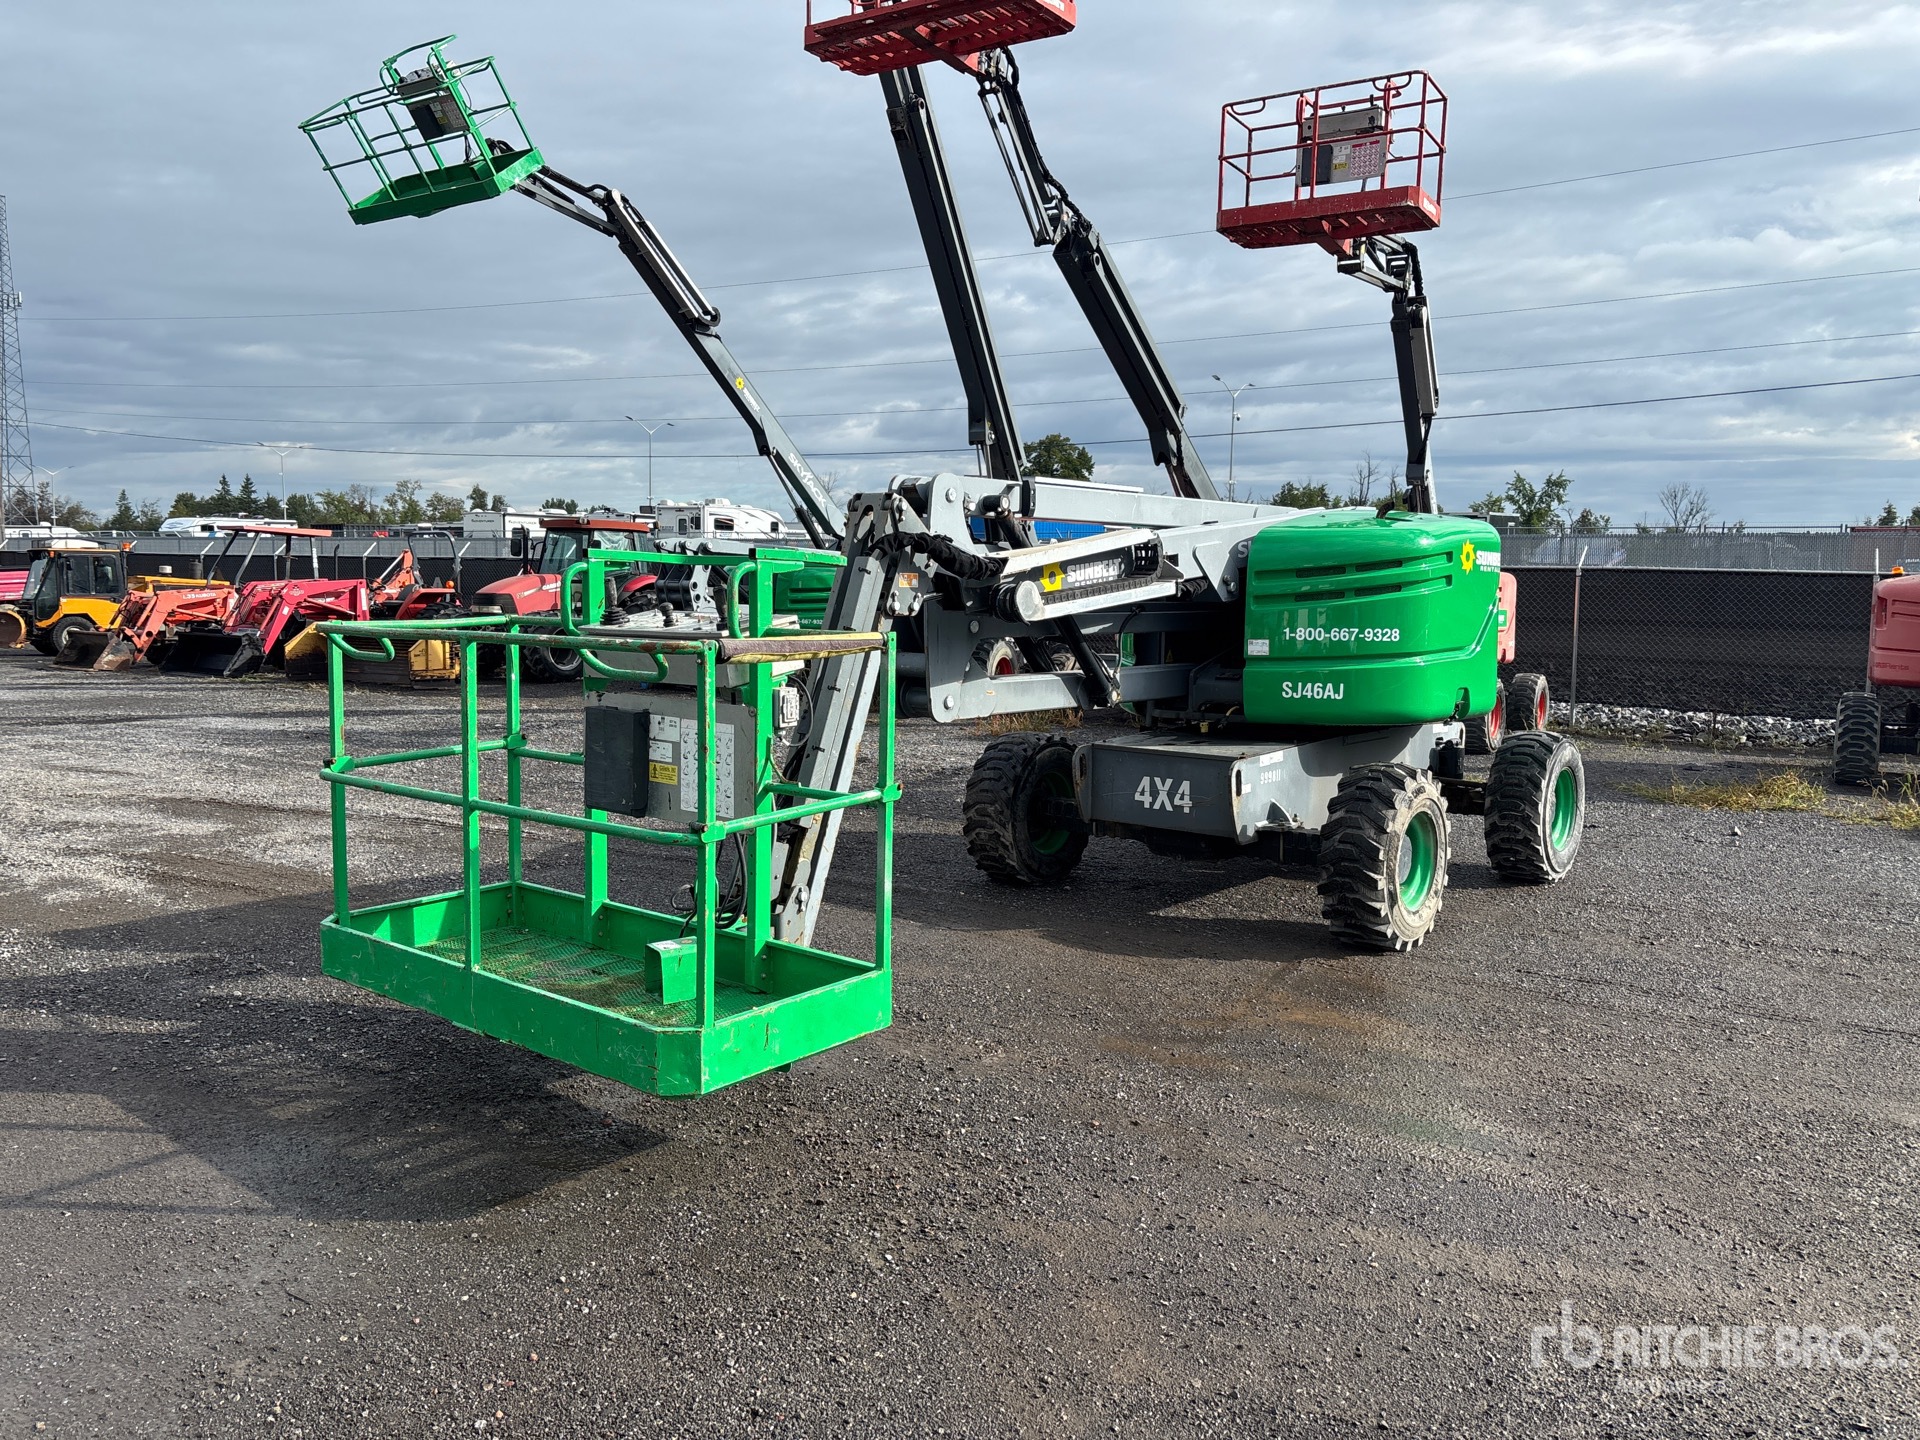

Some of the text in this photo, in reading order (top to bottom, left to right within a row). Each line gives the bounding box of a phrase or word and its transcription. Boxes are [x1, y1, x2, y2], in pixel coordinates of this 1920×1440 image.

[789, 452, 826, 508] SKYJACK
[1066, 558, 1121, 583] SUNBELT
[1283, 627, 1400, 642] 1-800-667-9328
[1281, 681, 1344, 700] SJ46AJ
[1134, 775, 1193, 814] 4X4
